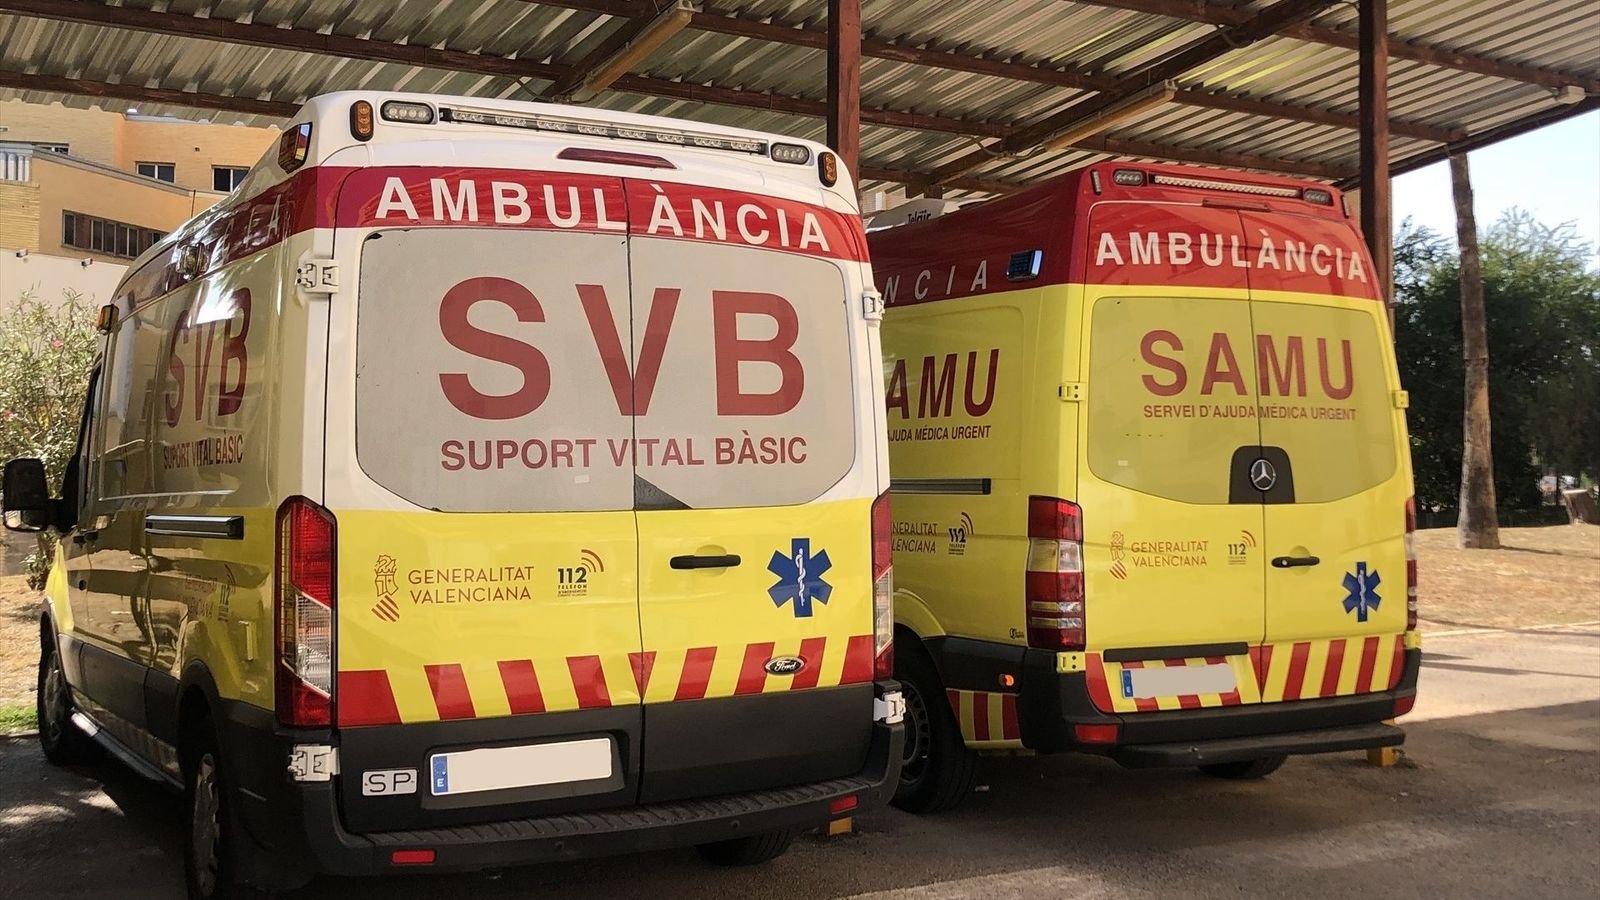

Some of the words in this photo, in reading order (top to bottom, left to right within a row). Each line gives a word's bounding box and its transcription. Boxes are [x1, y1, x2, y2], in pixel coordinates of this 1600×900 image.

[374, 176, 831, 252] AMBULÀNCIA
[1095, 228, 1367, 283] AMBULÀNCIA
[438, 276, 805, 420] SVB
[1139, 329, 1355, 401] SAMU
[1143, 405, 1195, 418] SERVEI
[1199, 404, 1257, 419] D'AJUDA
[1311, 407, 1357, 421] URGENT
[951, 424, 991, 440] URGENT
[440, 438, 597, 471] SUPORT
[607, 437, 704, 468] VITAL
[714, 430, 807, 466] BÀSIC
[948, 527, 966, 543] 112
[1131, 541, 1209, 553] GENERALITAT
[1228, 543, 1246, 555] 112
[1131, 555, 1208, 567] VALENCIANA
[408, 566, 534, 585] GENERALITAT
[557, 567, 587, 584] 112
[409, 586, 531, 604] VALENCIANA
[772, 658, 800, 672] Ford
[436, 778, 445, 788] E
